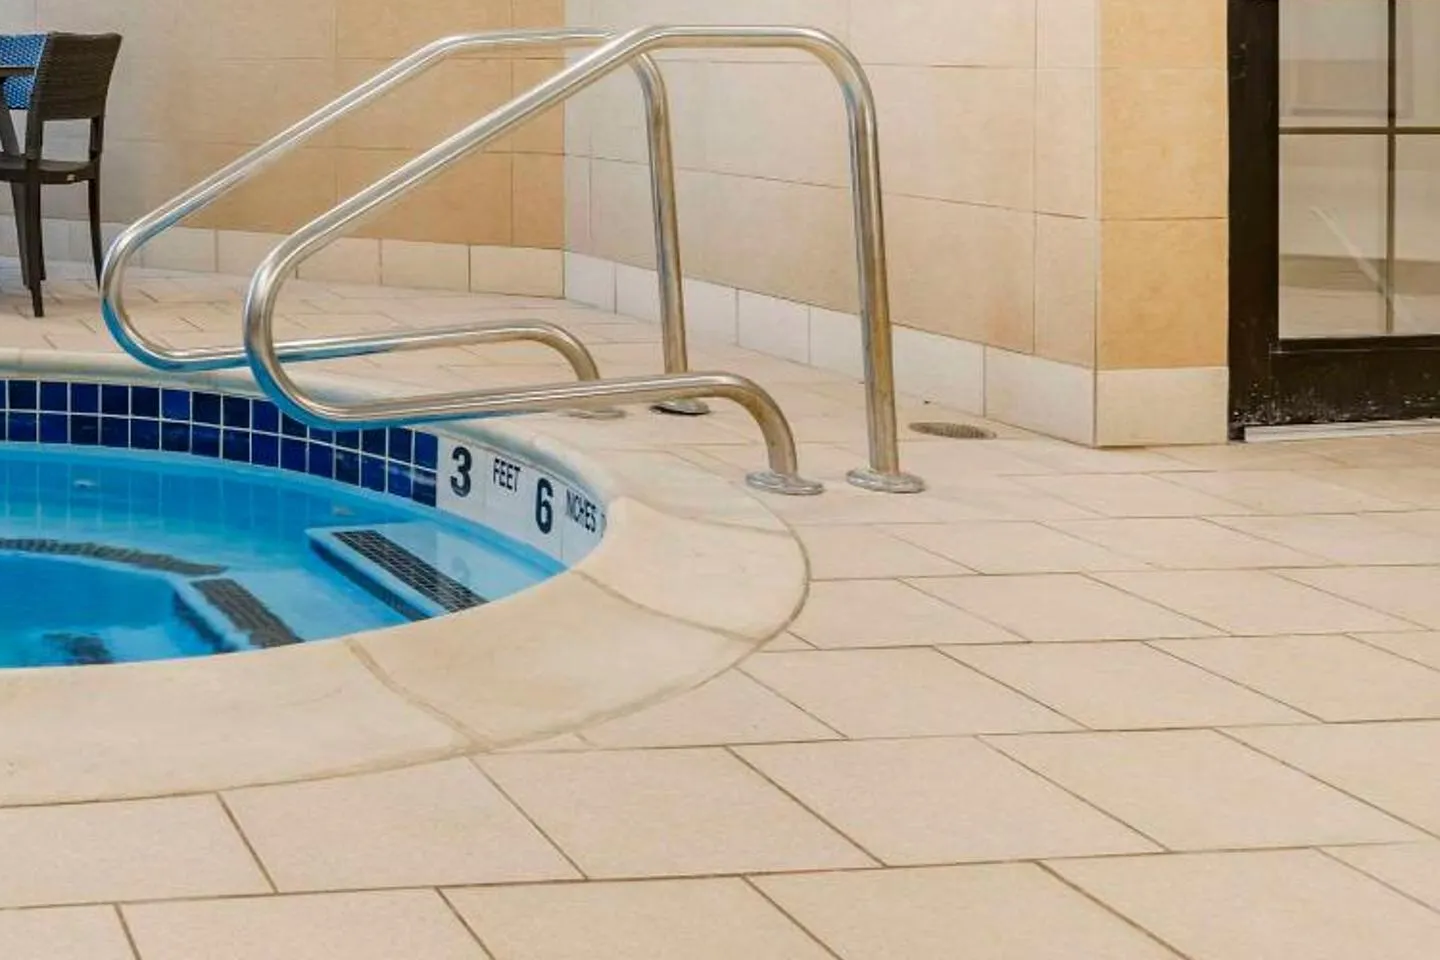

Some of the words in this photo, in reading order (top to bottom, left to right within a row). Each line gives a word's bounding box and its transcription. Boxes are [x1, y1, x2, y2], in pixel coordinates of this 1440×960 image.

[450, 446, 472, 498] 3
[493, 457, 521, 492] FEET
[535, 477, 554, 535] 6
[566, 488, 597, 533] INCHES
